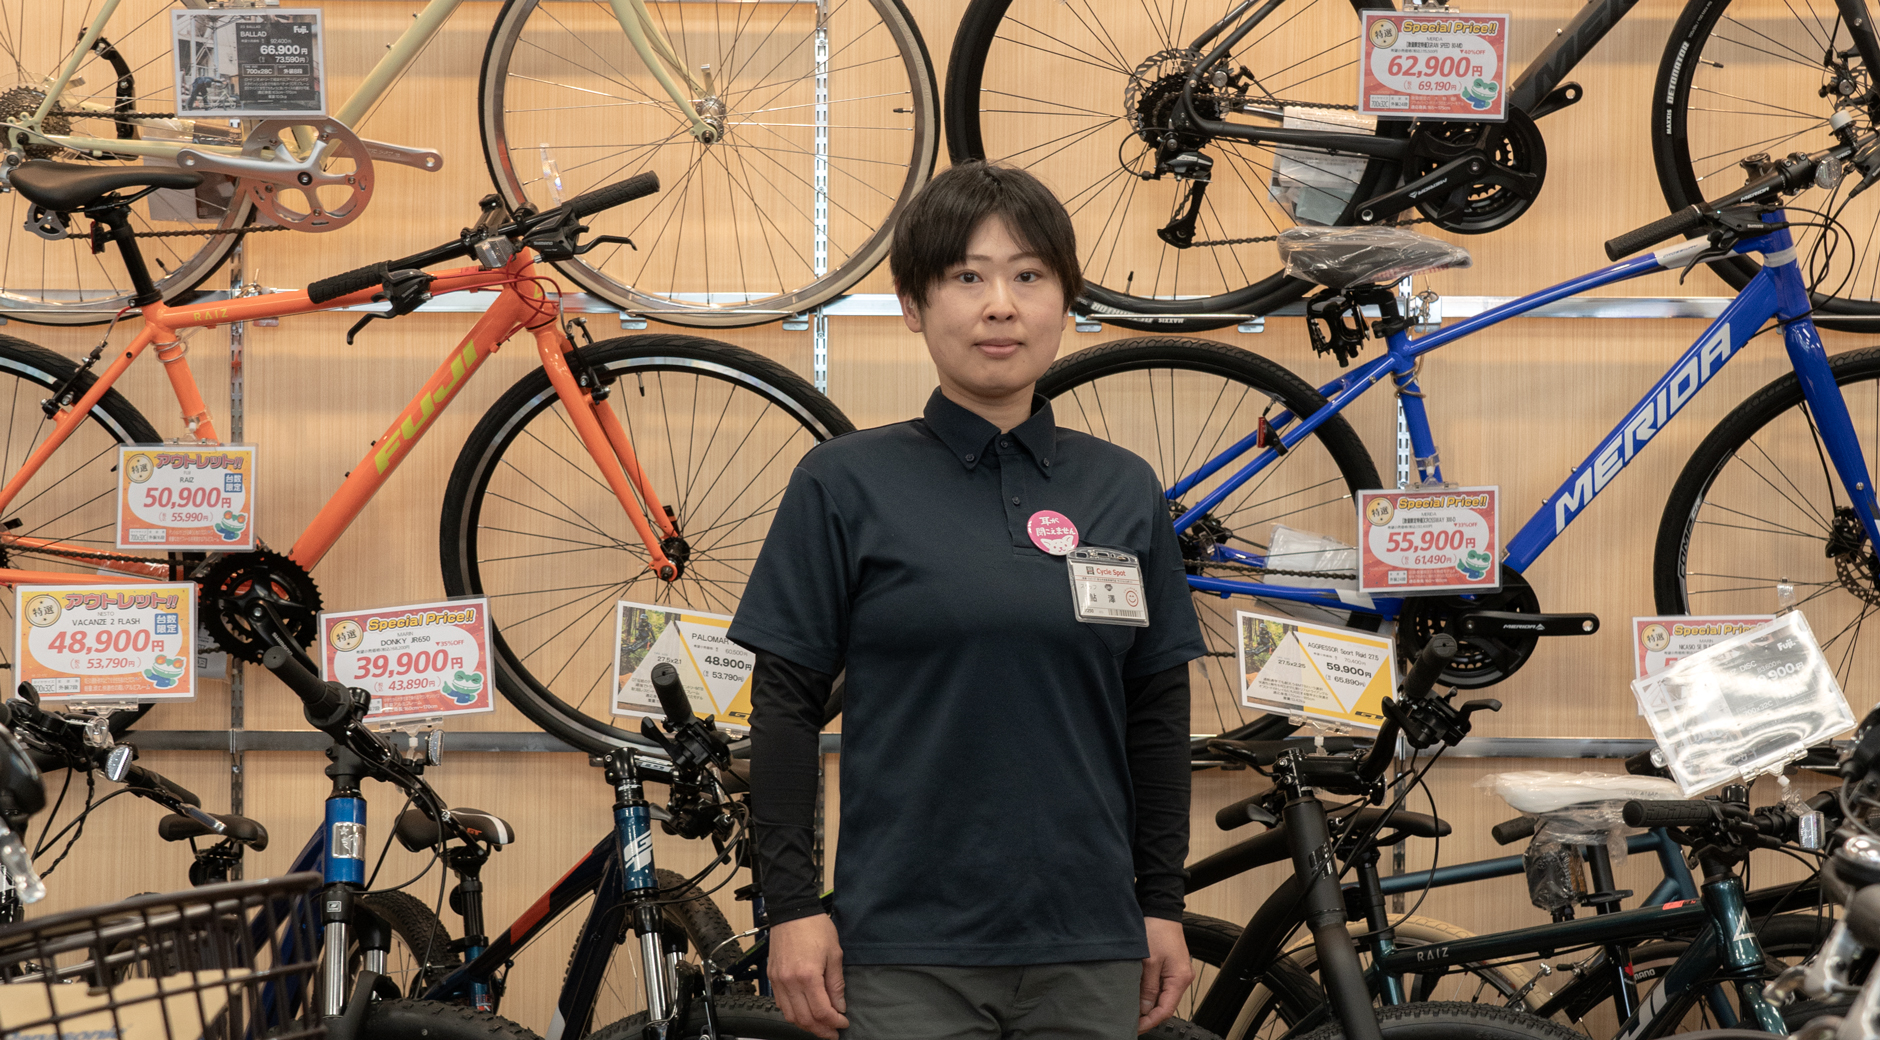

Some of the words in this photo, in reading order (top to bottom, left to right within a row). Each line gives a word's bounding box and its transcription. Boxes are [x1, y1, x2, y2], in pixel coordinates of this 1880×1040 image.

[1374, 28, 1393, 39] 特選
[1403, 21, 1451, 34] Special
[1454, 22, 1497, 34] Price!!
[1388, 55, 1483, 78] 62,900円
[1667, 41, 1690, 105] DETONATOR
[1740, 187, 1769, 202] MERIDA
[193, 308, 229, 322] RAIZ
[374, 339, 478, 476] FUJI
[1556, 322, 1731, 536] MERIDA
[131, 463, 148, 474] 特選
[156, 453, 244, 470] アウトレット!!
[225, 474, 242, 483] 台数
[225, 483, 242, 492] 限定
[143, 487, 232, 509] 50,900円
[1398, 497, 1444, 510] Special
[1446, 496, 1487, 507] Price!!
[1371, 506, 1389, 517] 特選
[1038, 516, 1060, 526] 耳が
[1035, 527, 1077, 537] 聞こえません
[1386, 530, 1476, 553] 55,900円
[1096, 567, 1112, 576] Cycle
[1112, 568, 1126, 577] Spot
[65, 592, 179, 610] アウトレット!!
[32, 604, 55, 618] 特選
[72, 618, 107, 626] VACANZE
[156, 614, 177, 624] 台数
[368, 613, 423, 632] Special
[426, 610, 475, 625] Price!!
[156, 624, 177, 634] 限定
[336, 629, 357, 643] 特選
[1674, 625, 1721, 637] Special
[48, 629, 165, 655] 48,900円
[380, 638, 407, 647] DONKY
[410, 635, 431, 644] JR650
[691, 633, 730, 646] PALOMAR
[1647, 632, 1665, 643] 特選
[1307, 642, 1338, 653] AGGRESSOR
[1340, 648, 1354, 657] Sport
[354, 649, 463, 680] 39,900円
[1739, 660, 1757, 672] DISC
[1416, 945, 1449, 963] RAIZ
